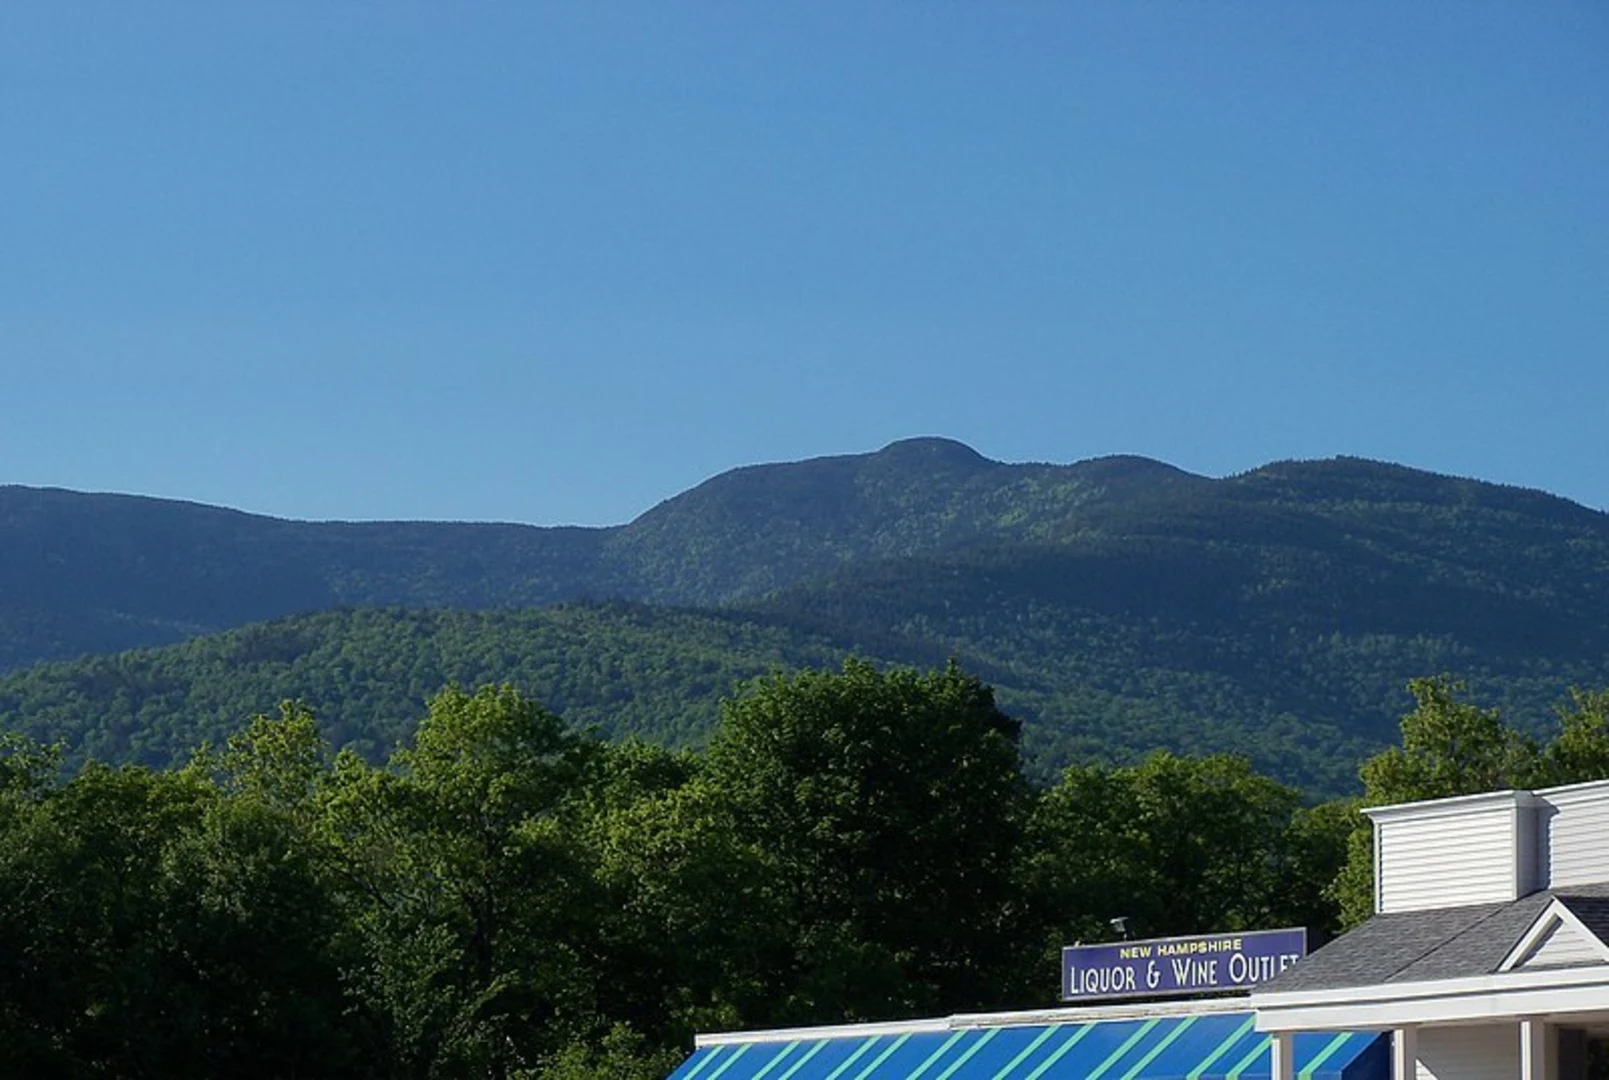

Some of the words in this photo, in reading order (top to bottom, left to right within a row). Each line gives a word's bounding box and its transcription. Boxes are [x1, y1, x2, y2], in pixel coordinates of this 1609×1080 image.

[1120, 947, 1153, 960] NEW
[1157, 939, 1242, 956] HAMPSHIRE
[1071, 966, 1136, 994] LIQUOR
[1146, 961, 1160, 988] &
[1171, 957, 1218, 986] WINE
